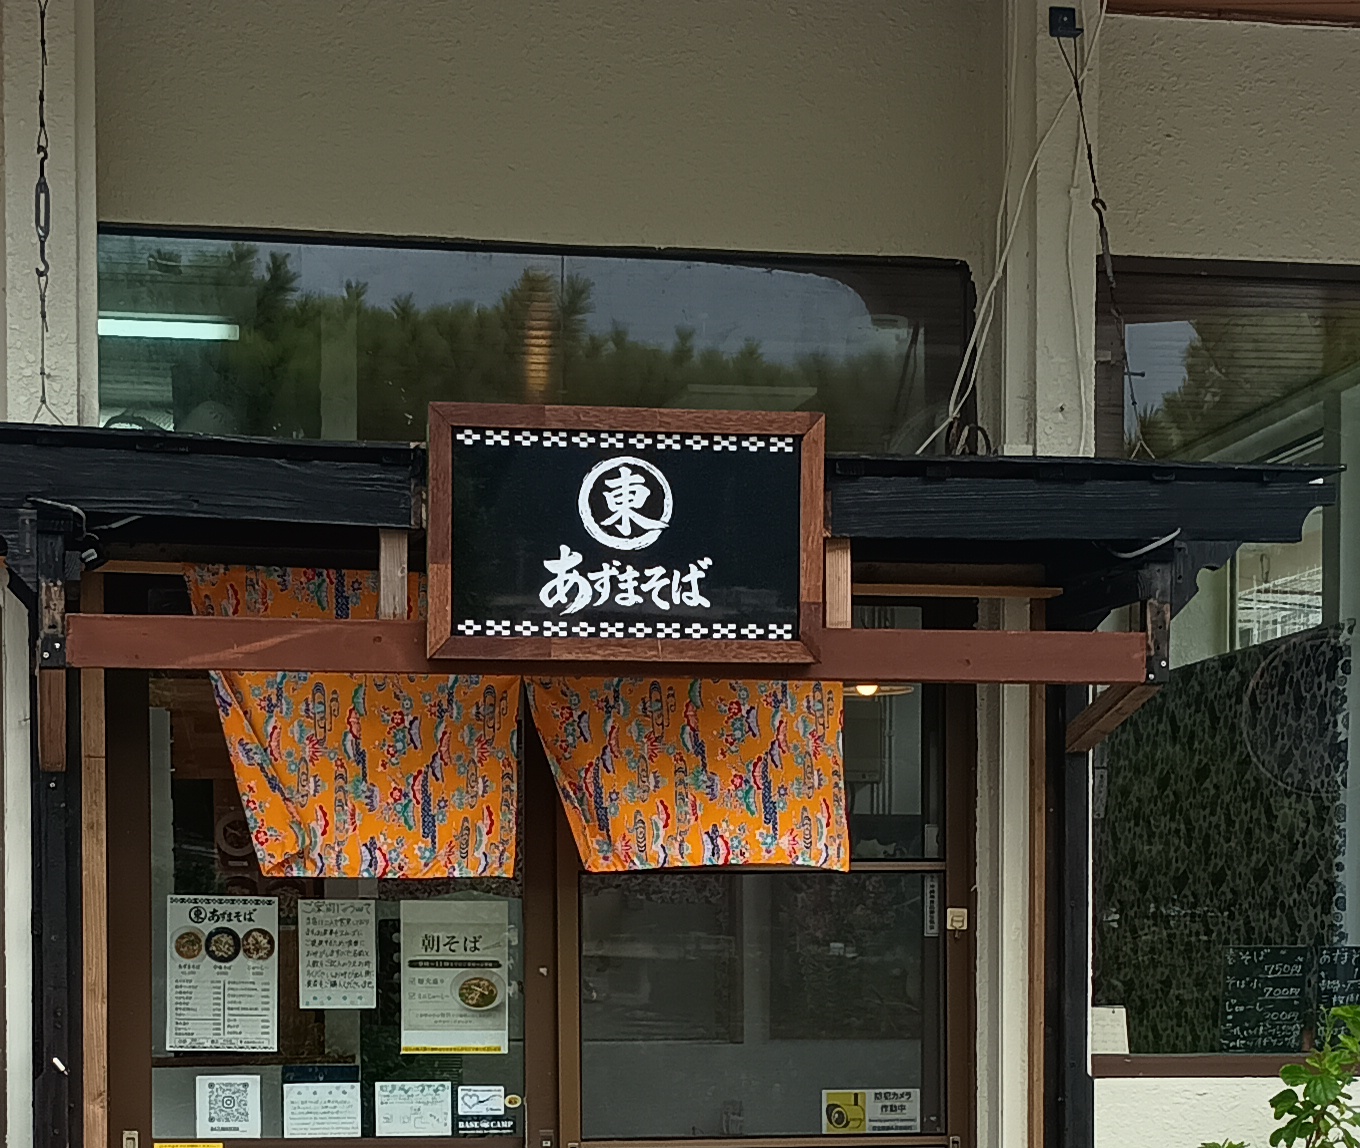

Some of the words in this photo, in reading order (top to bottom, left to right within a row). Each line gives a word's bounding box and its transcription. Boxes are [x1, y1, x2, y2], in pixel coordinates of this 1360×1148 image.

[601, 467, 670, 537] 東
[539, 544, 713, 616] あずまそば
[208, 908, 258, 924] あずまそば
[422, 934, 483, 953] 朝そば
[490, 1120, 514, 1129] CAMP
